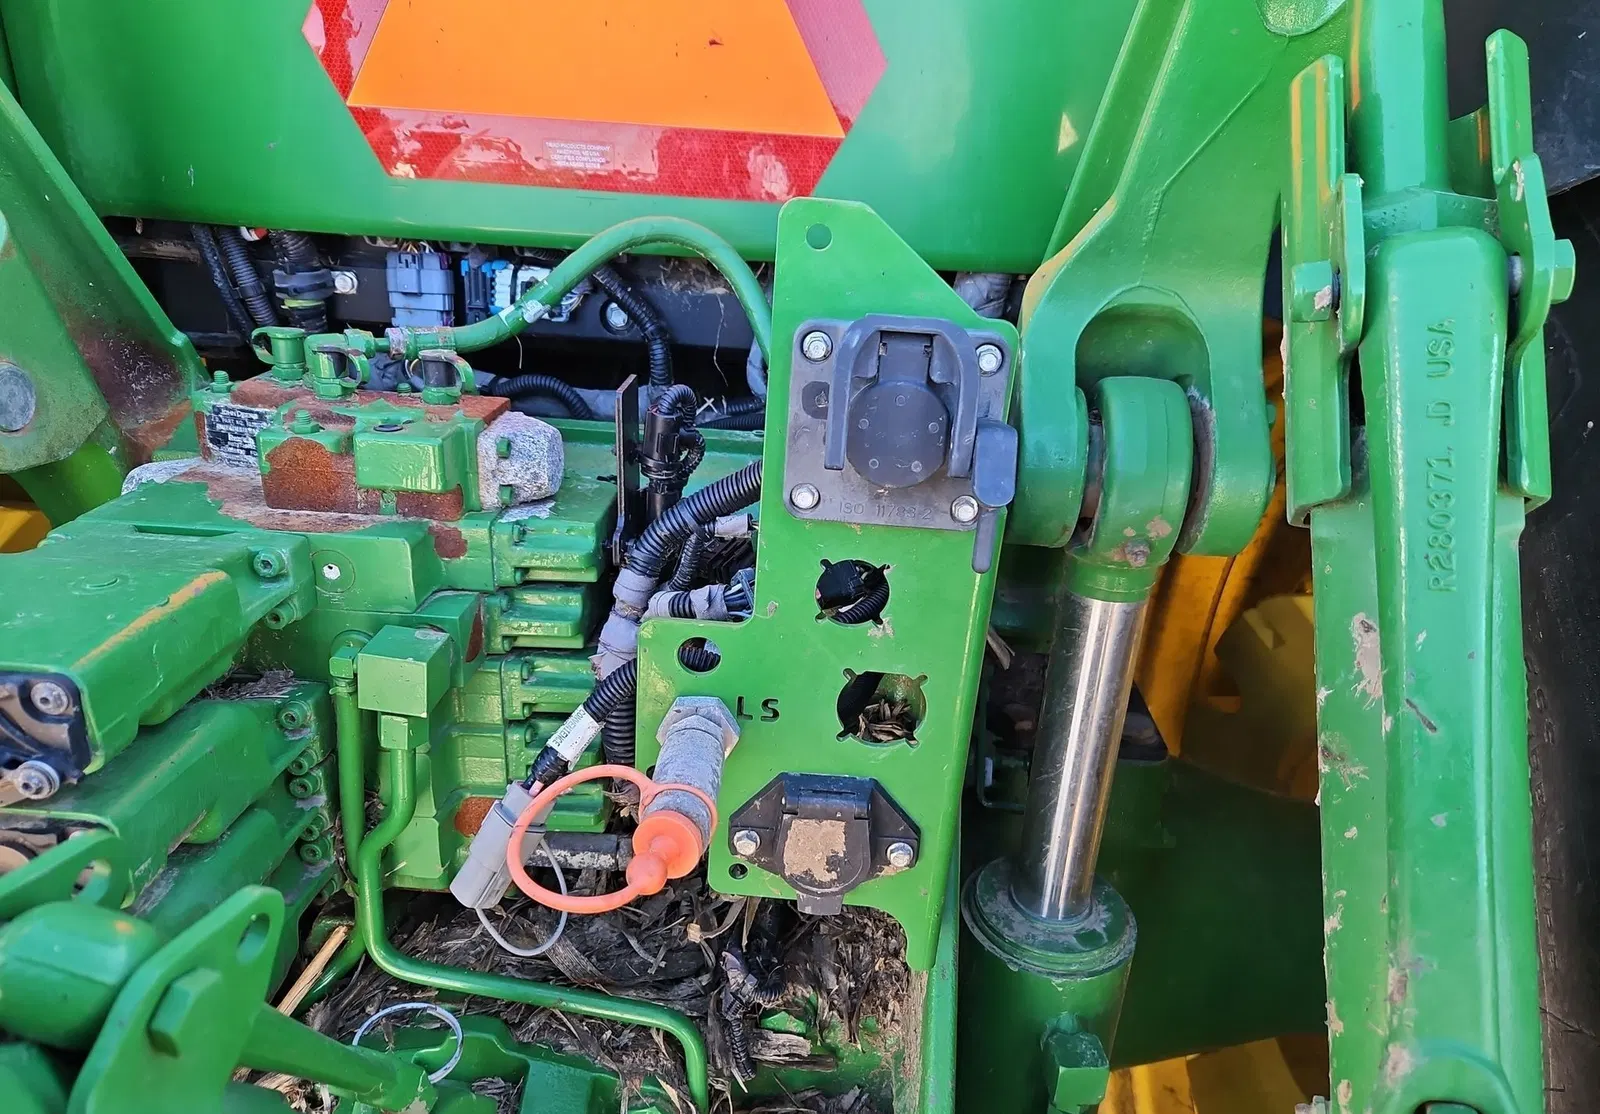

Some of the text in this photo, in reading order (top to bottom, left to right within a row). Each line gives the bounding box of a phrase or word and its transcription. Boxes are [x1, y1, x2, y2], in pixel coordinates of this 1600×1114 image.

[1426, 317, 1456, 379] USA
[840, 502, 865, 515] ISO
[736, 696, 780, 723] LS
